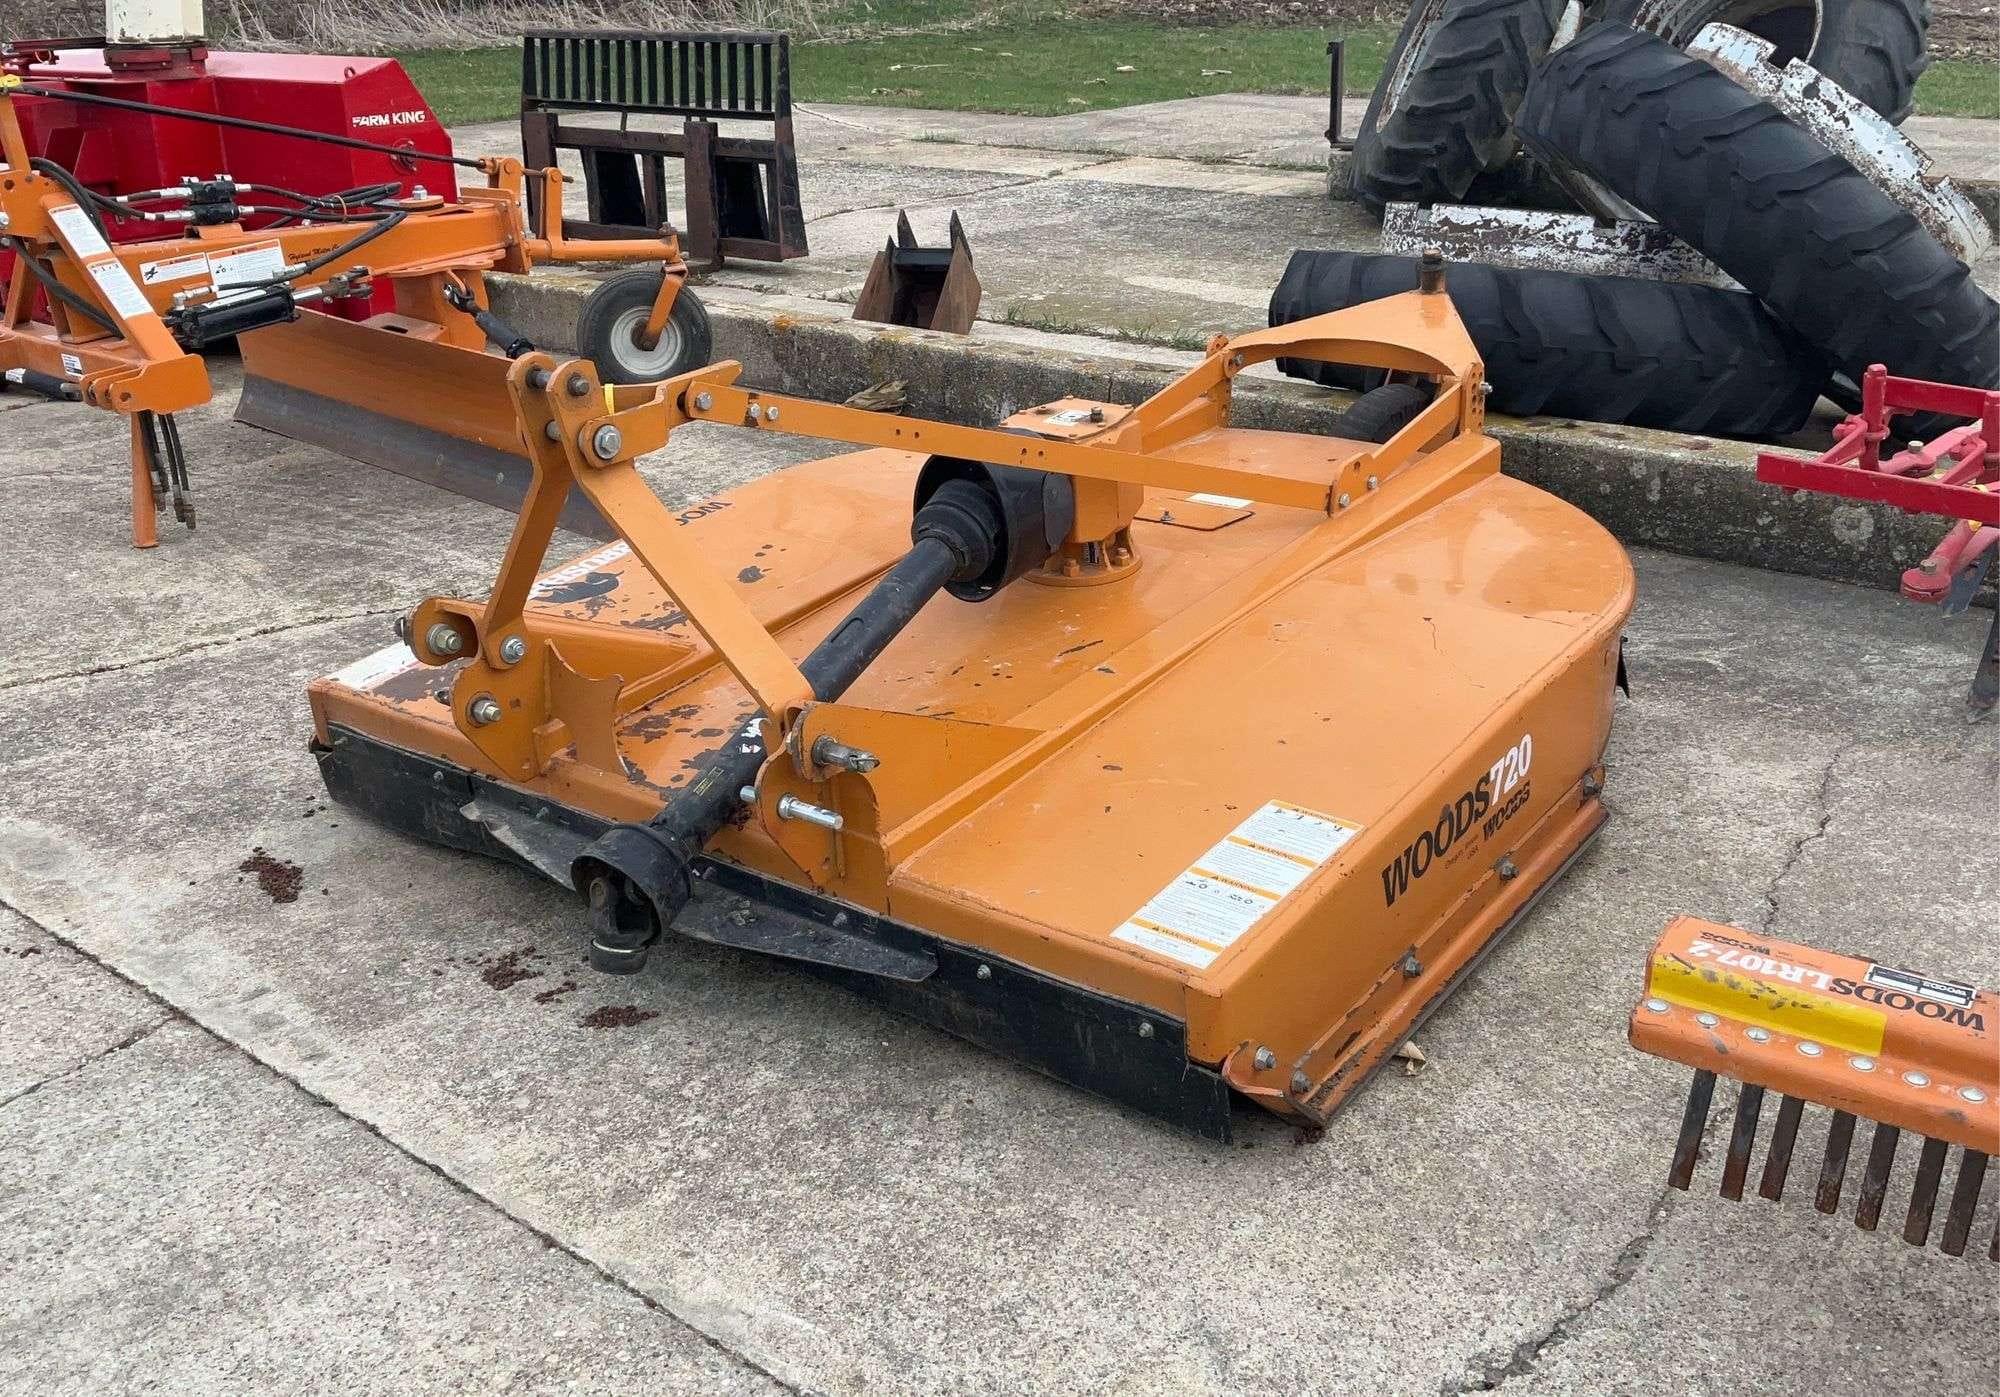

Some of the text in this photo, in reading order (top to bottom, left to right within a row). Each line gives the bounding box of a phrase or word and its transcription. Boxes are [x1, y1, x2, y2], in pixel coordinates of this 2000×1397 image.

[352, 110, 426, 128] FARM KING
[1381, 771, 1491, 908] WOODS
[1489, 733, 1532, 807] 720
[1688, 939, 1986, 1032] WOODS LR107-2
